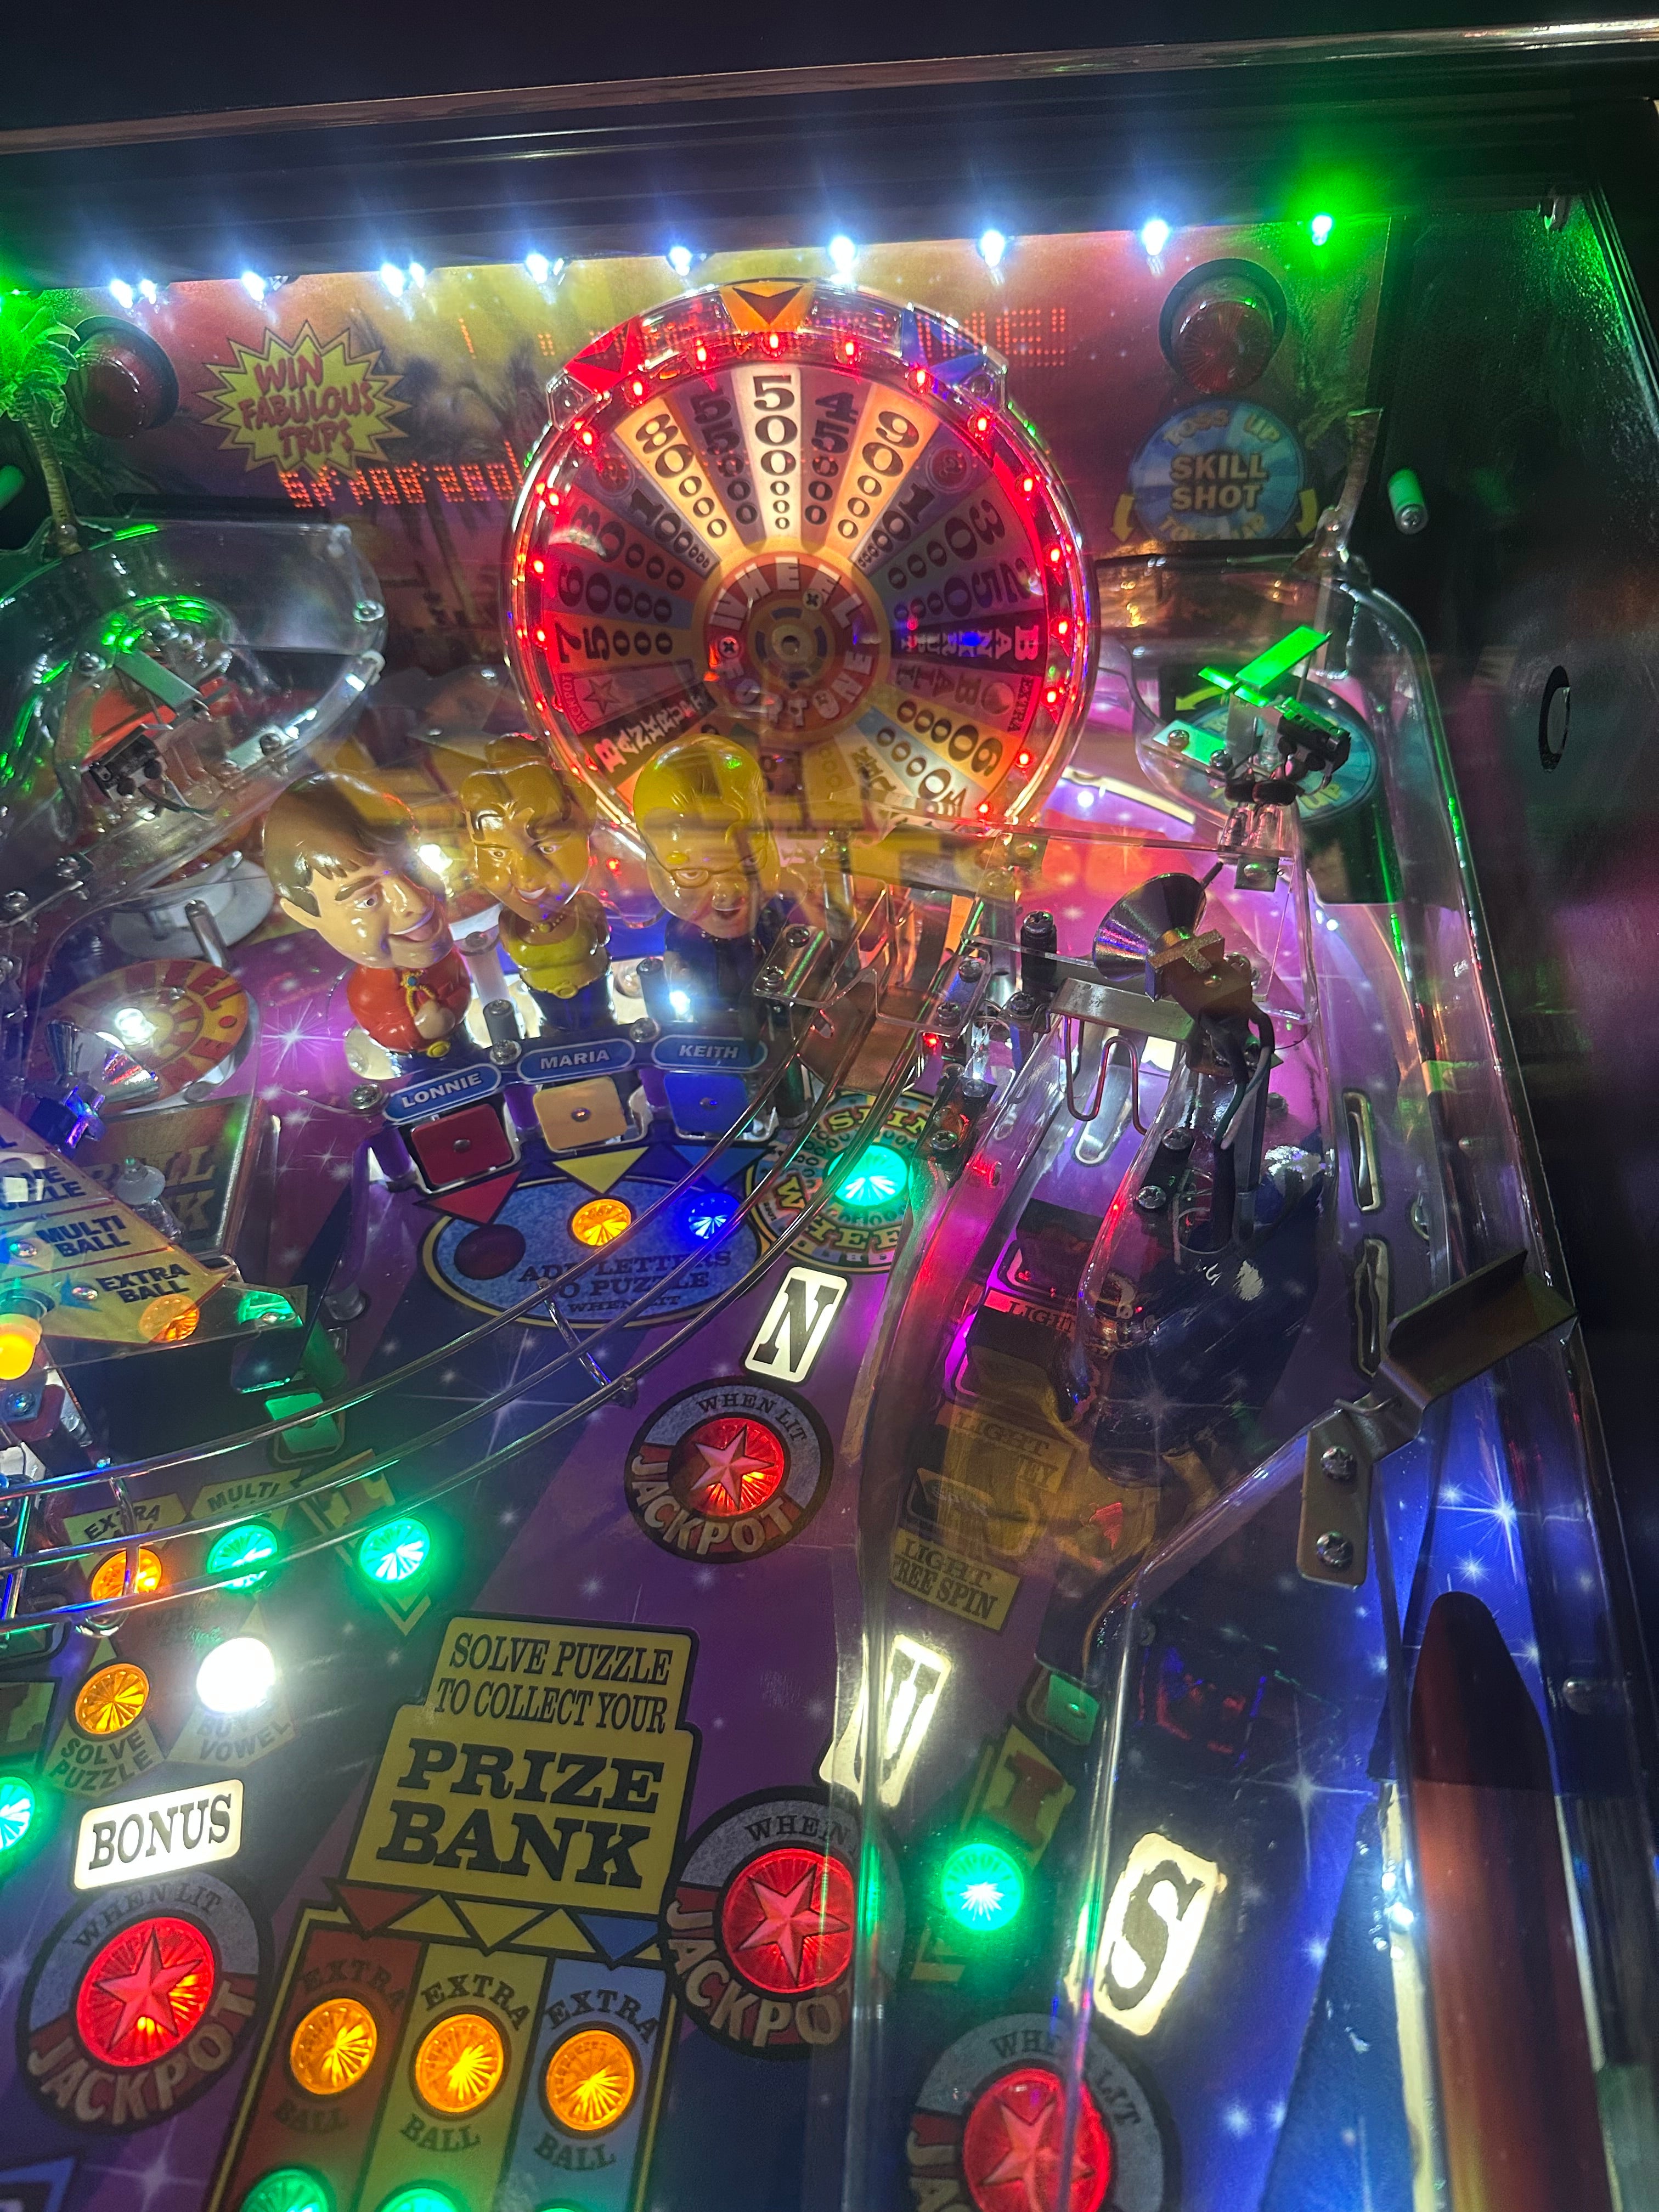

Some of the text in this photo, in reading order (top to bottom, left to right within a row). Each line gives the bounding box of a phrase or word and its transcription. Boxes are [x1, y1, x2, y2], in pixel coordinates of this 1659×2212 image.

[254, 354, 324, 392] WIN
[238, 381, 376, 432] FABULOUS
[278, 422, 354, 458] TRIPS
[690, 386, 758, 525] 55000
[753, 375, 798, 529] 500000
[805, 392, 859, 525] 45000
[636, 414, 727, 538] 80000
[837, 410, 920, 539] 90000
[1170, 454, 1268, 481] SKILL
[1171, 485, 1261, 511] SHOT
[888, 499, 1006, 590] 30000
[554, 622, 673, 663] 75000
[1007, 676, 1035, 733] EXTRA
[897, 699, 1003, 777] 60000
[540, 1049, 611, 1070] MARIA
[679, 1044, 738, 1059] KEITH
[401, 1073, 482, 1108] LONNIE
[36, 1215, 127, 1244] MULTI
[55, 1233, 131, 1257] BALL
[95, 1263, 190, 1292] EXTRA
[116, 1279, 190, 1302] BALL
[753, 1278, 840, 1373] N
[697, 1393, 808, 1441] WHEN LIT
[207, 1482, 280, 1512] MULTI
[631, 1454, 794, 1555] JACKPOT
[84, 1504, 161, 1541] EXRA
[936, 1577, 998, 1620] SPIN
[450, 1632, 673, 1685] SOLVE PUZZLE
[435, 1677, 668, 1733] TO COLLECT YOUR
[61, 1729, 146, 1765] SOLVE
[200, 1720, 291, 1761] VOWEL
[49, 1749, 153, 1791] PUZZLE
[397, 1738, 664, 1813] PRIZE
[89, 1794, 232, 1870] BONUS
[376, 1799, 650, 1889] BANK
[744, 1815, 852, 1844] WHEN
[1100, 1860, 1204, 2011] S
[667, 1901, 850, 2047] JACKPO
[421, 1974, 532, 2030] EXTRA
[544, 1989, 661, 2043] EXTRA
[27, 1980, 255, 2125] JACKPOT
[400, 2114, 482, 2151] BALL
[533, 2134, 617, 2170] BALL
